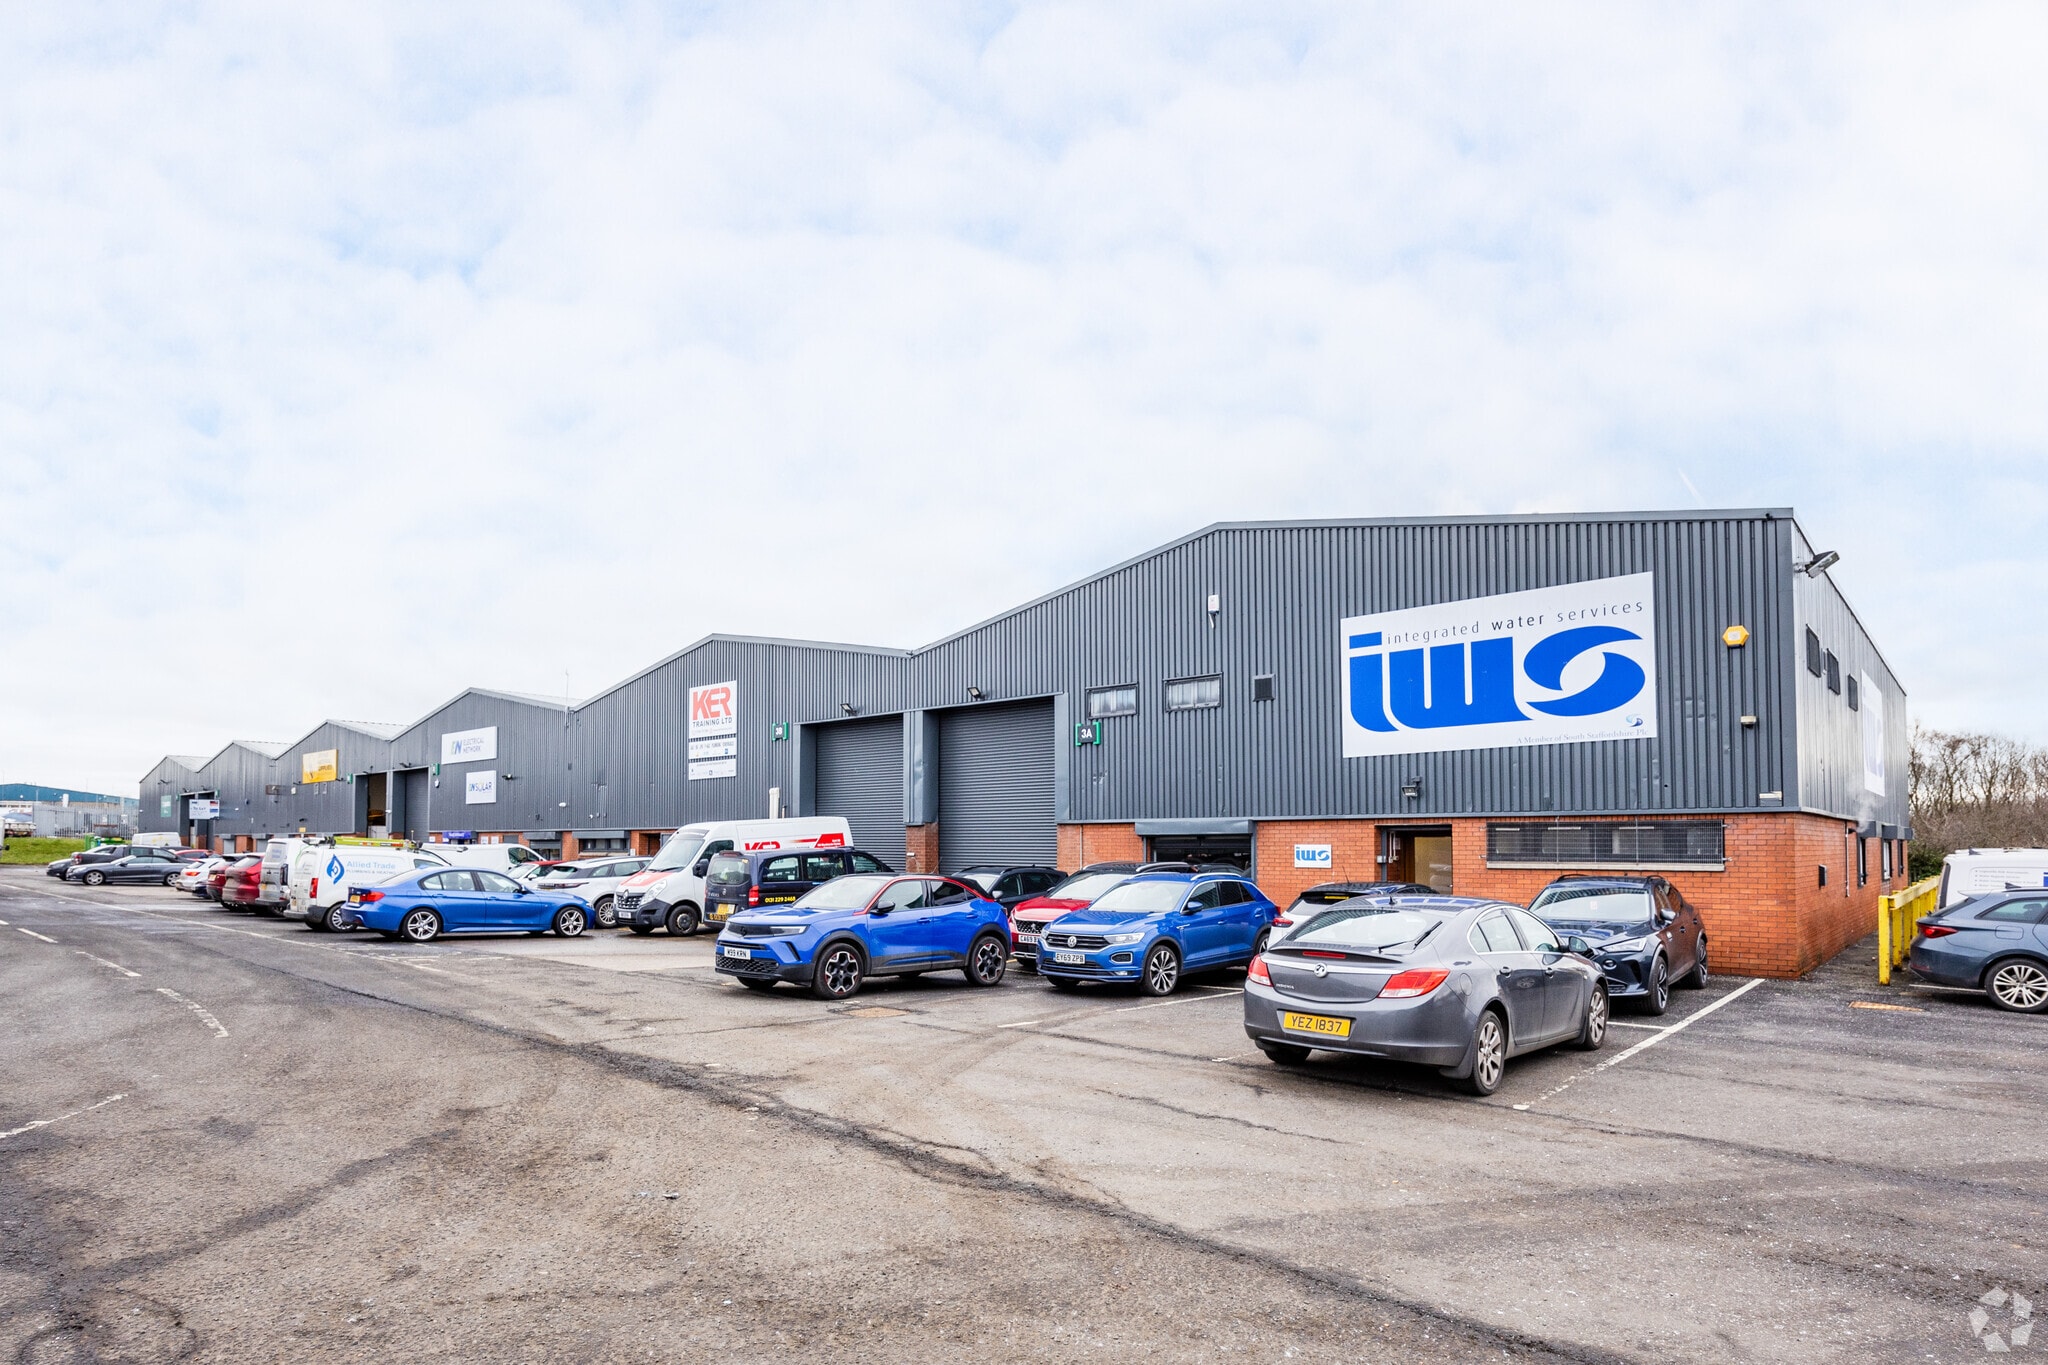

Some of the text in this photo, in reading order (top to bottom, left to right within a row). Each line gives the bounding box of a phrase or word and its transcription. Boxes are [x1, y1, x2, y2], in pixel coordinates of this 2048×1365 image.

[1387, 601, 1643, 645] integrated water services
[1349, 625, 1646, 733] iws
[692, 686, 732, 720] KER
[692, 717, 733, 729] TRAINING LTD
[1081, 728, 1093, 739] 3A
[1523, 735, 1553, 744] Member
[1563, 732, 1585, 741] South
[1587, 729, 1633, 739] Staffordshire
[1636, 728, 1648, 736] Plc
[1295, 846, 1330, 861] iws
[346, 860, 396, 869] Allied Trade
[1291, 1015, 1342, 1032] YEZ 1837
